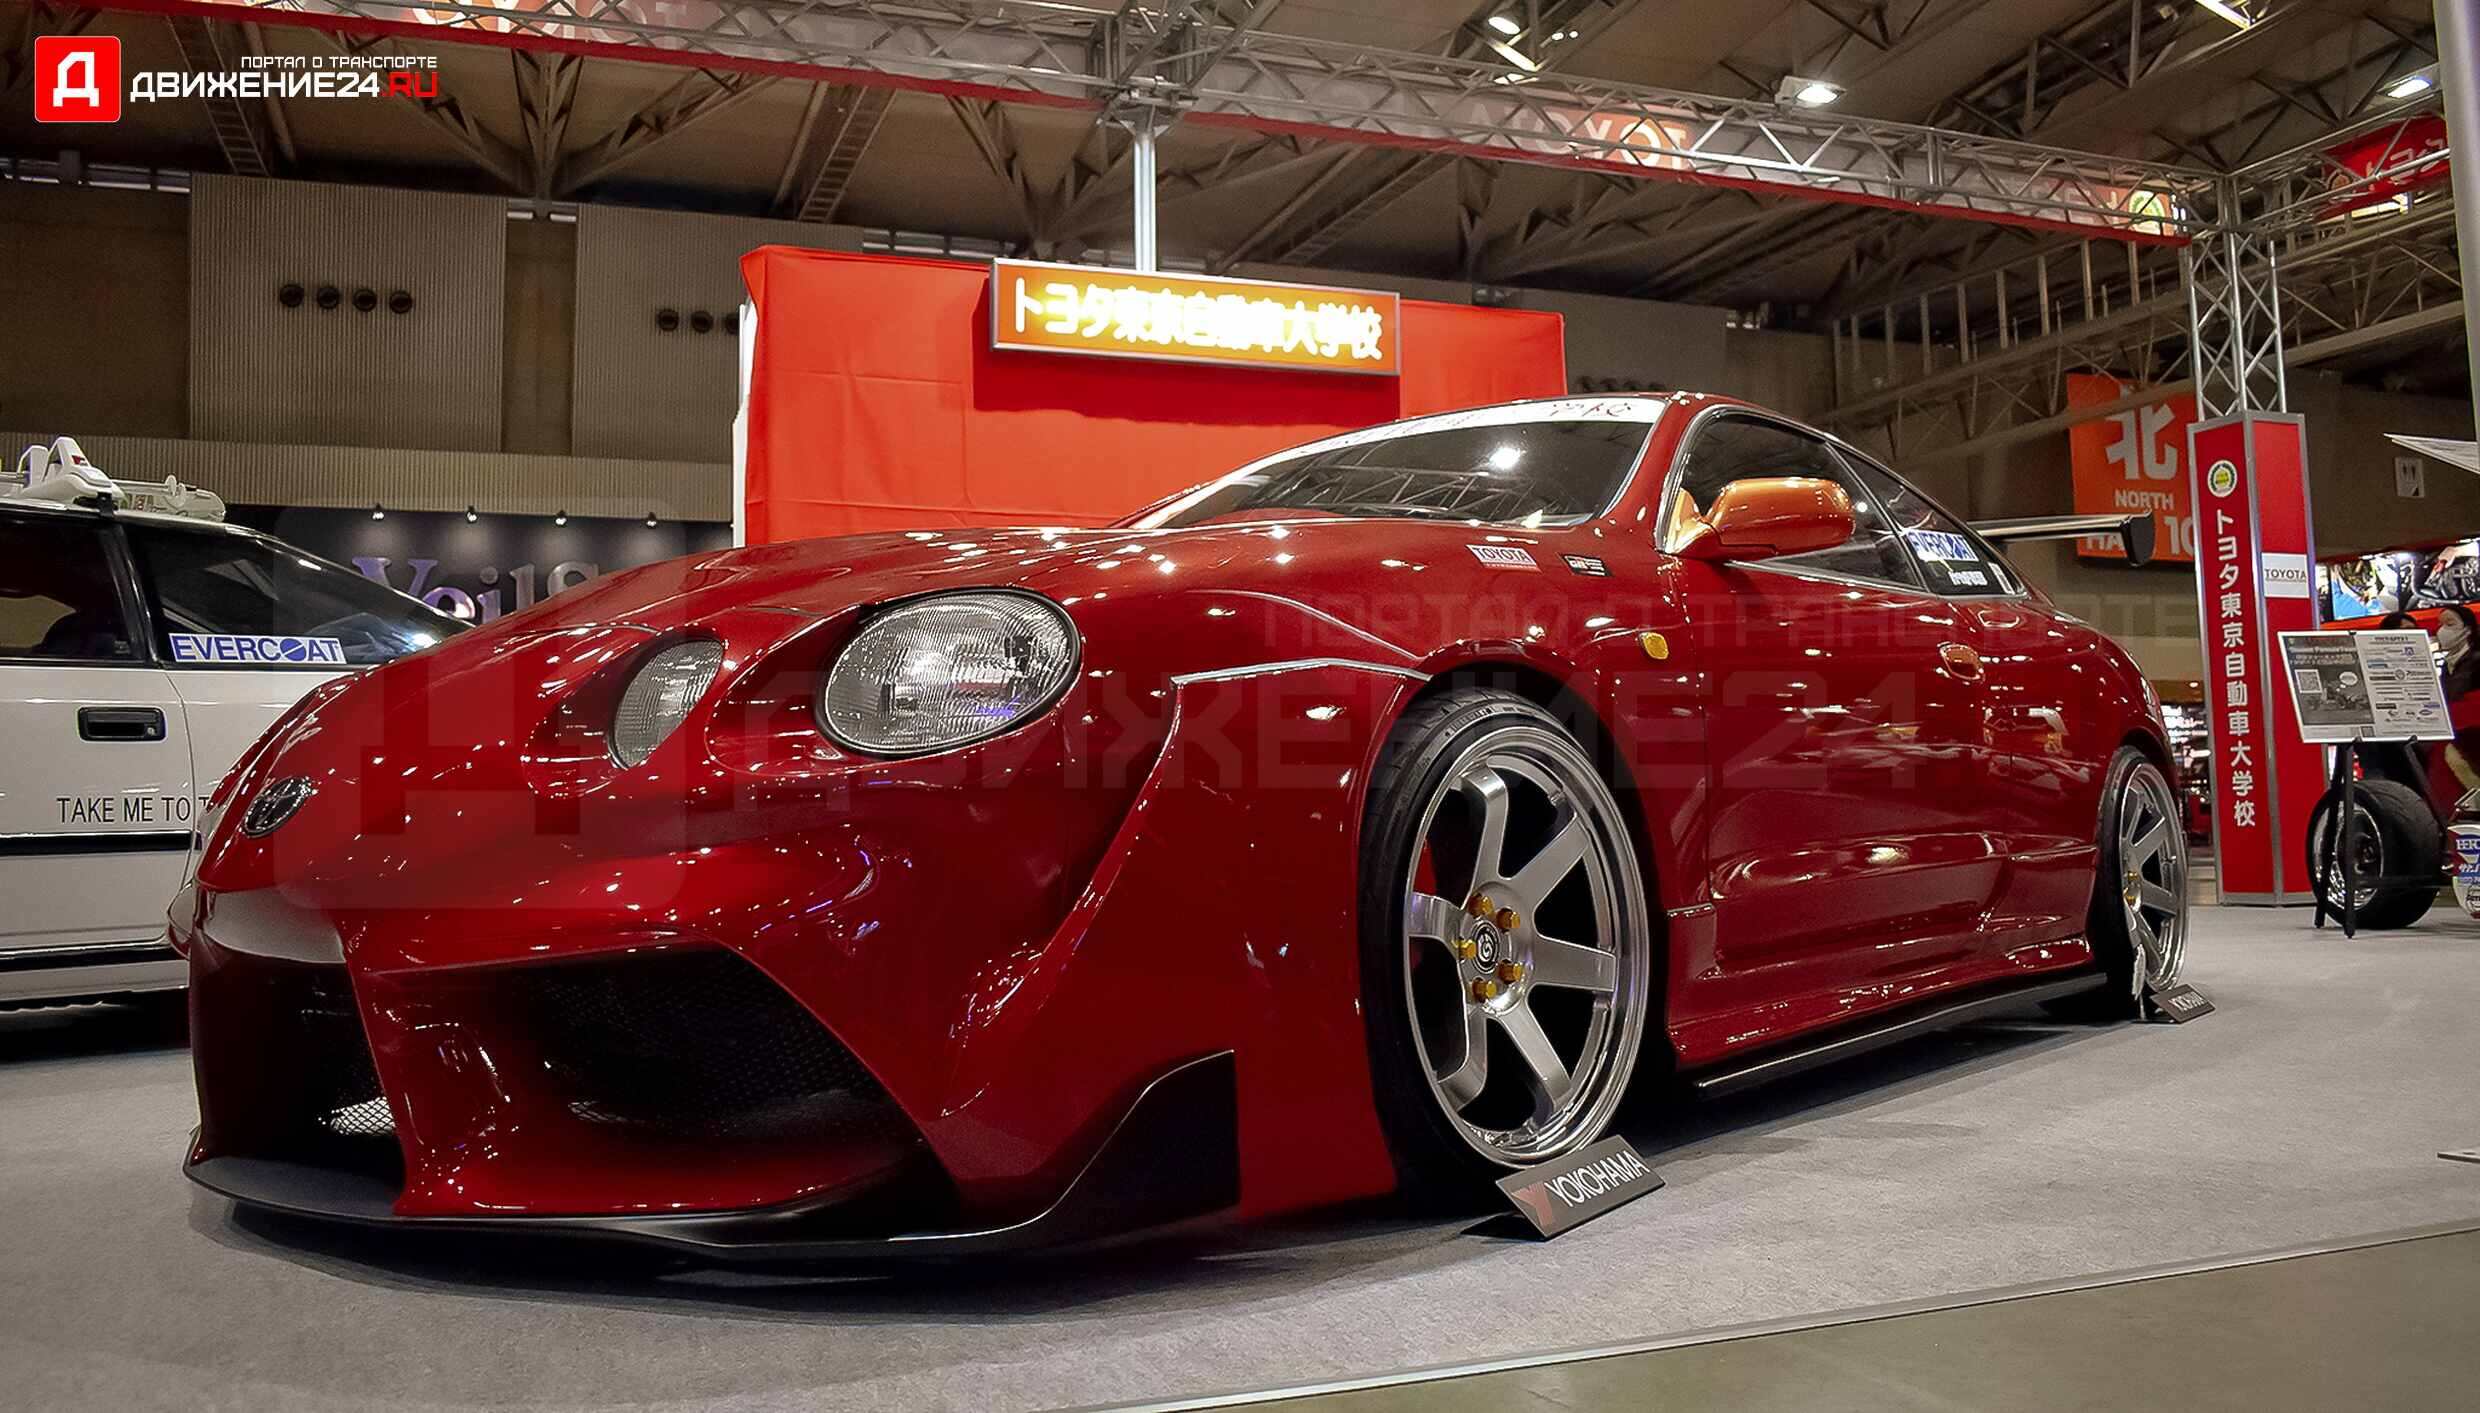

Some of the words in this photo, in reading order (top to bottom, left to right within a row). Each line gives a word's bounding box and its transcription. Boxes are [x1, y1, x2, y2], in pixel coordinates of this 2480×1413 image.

[2104, 384, 2178, 480] 北
[2115, 489, 2174, 510] NORTH
[1472, 547, 1532, 563] TOYOTA
[2264, 567, 2307, 580] TOYOTA
[172, 635, 338, 662] EVERCOAT
[2215, 508, 2256, 827] トヨタ東京自動車大学校
[57, 798, 114, 823] TAKE
[124, 797, 153, 822] ME
[162, 797, 191, 822] TO
[1544, 1150, 1650, 1208] YOKOHAMA
